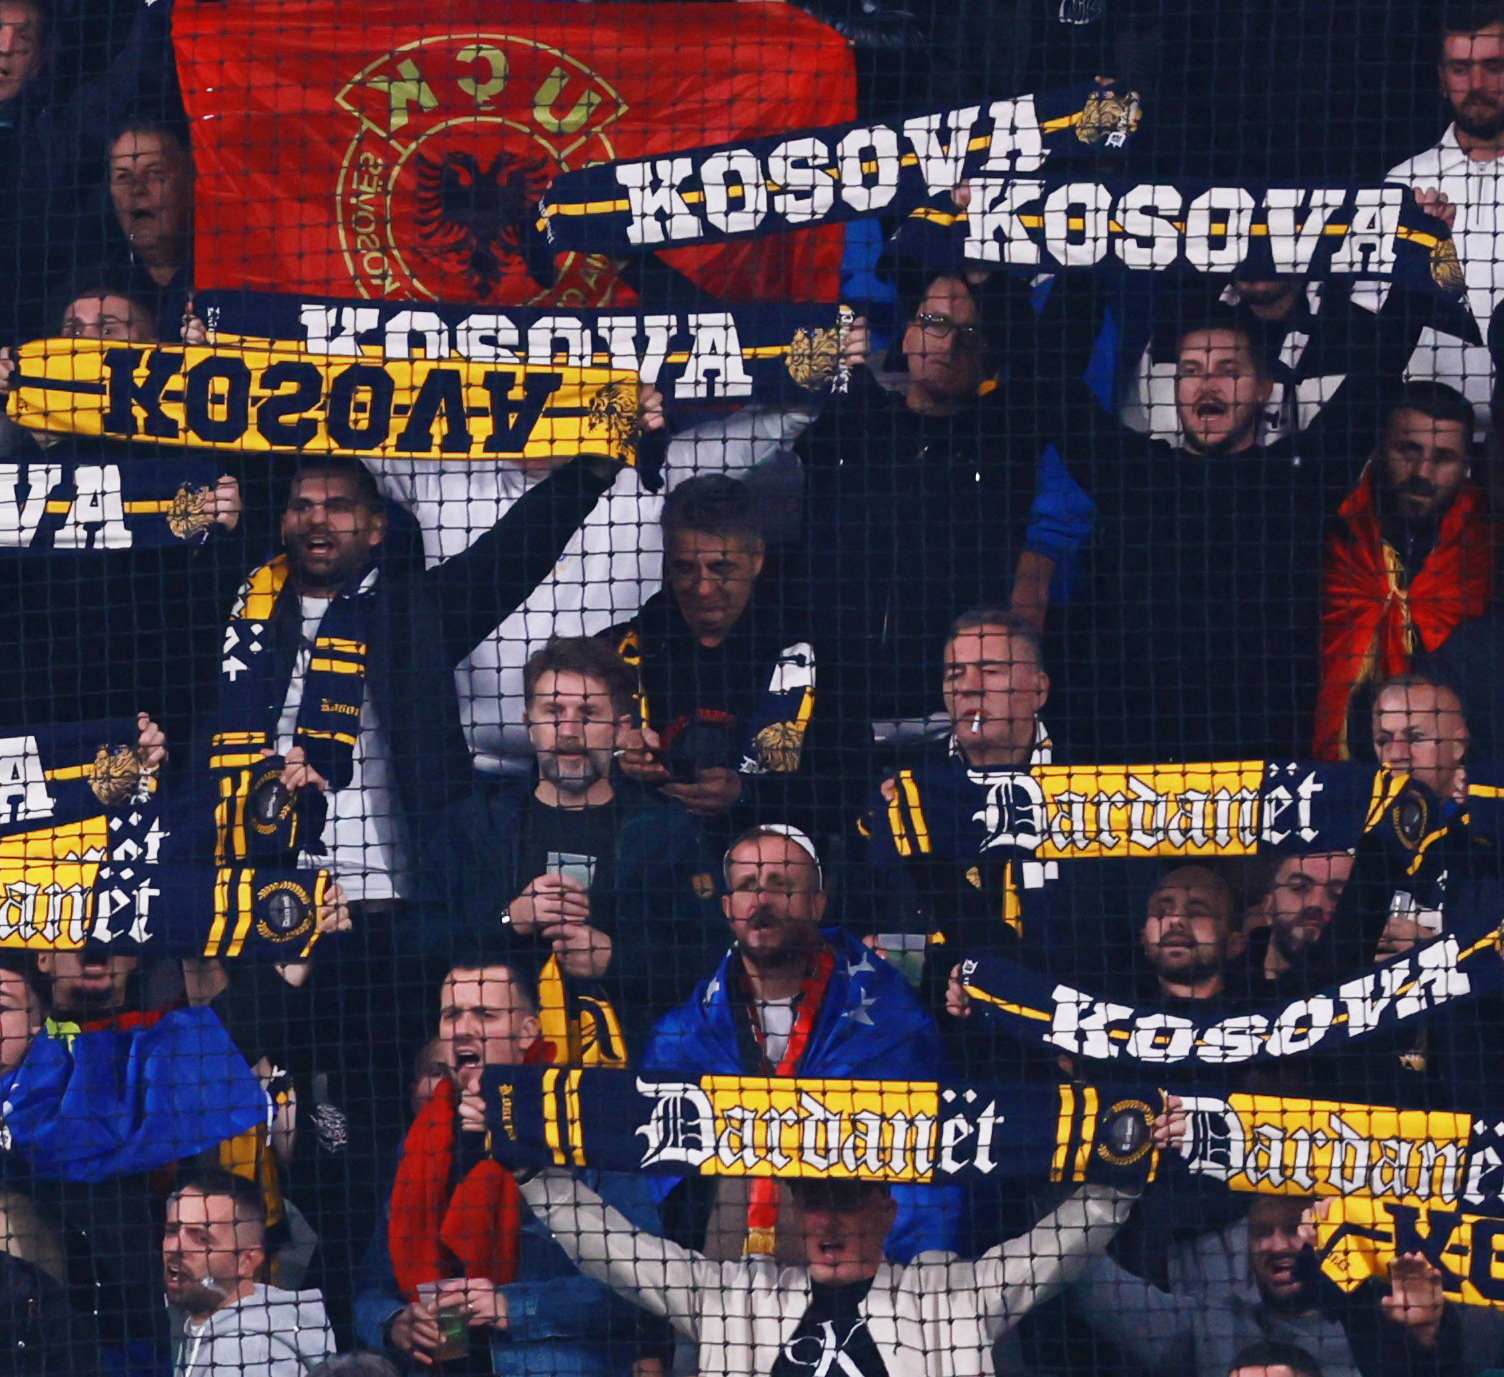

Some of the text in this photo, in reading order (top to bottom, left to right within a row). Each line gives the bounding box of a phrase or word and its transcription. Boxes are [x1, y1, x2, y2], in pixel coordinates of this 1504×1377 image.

[616, 94, 1051, 246] KOSOVA
[962, 176, 1406, 276] KOSOVA
[966, 763, 1323, 852] Dardanët
[1044, 934, 1472, 1064] KOSOVA
[635, 1076, 1005, 1176] Dardanët
